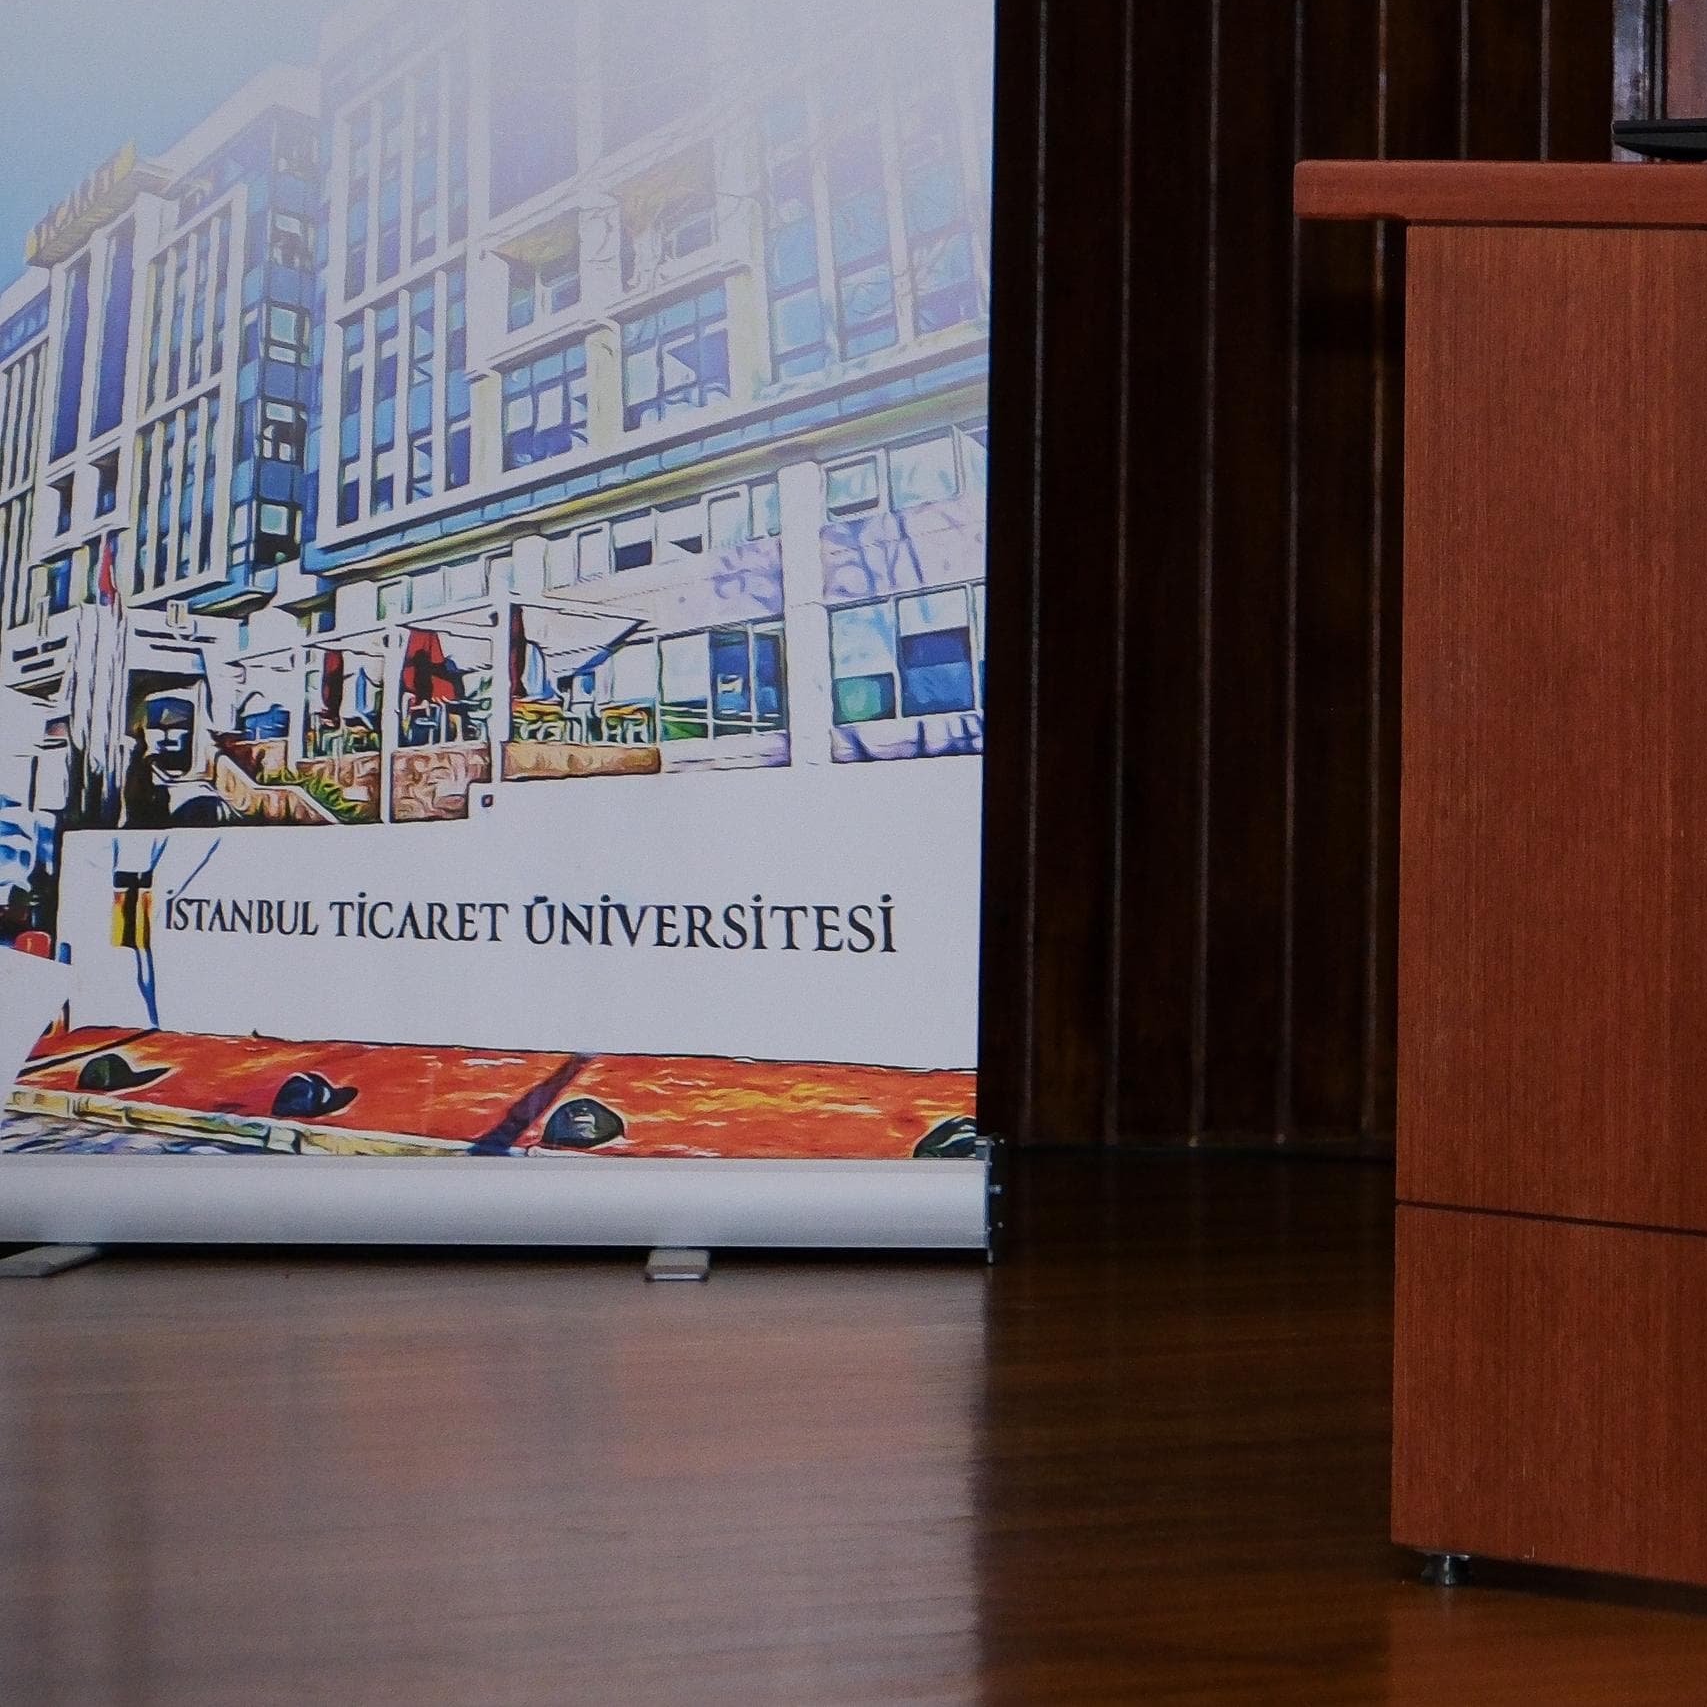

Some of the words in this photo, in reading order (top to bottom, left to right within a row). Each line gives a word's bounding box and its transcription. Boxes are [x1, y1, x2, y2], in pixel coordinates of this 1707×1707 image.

[165, 889, 319, 936] İSTANBUL
[329, 892, 509, 942] TİCARET
[522, 893, 898, 953] ÜNİVERSİTESİ
